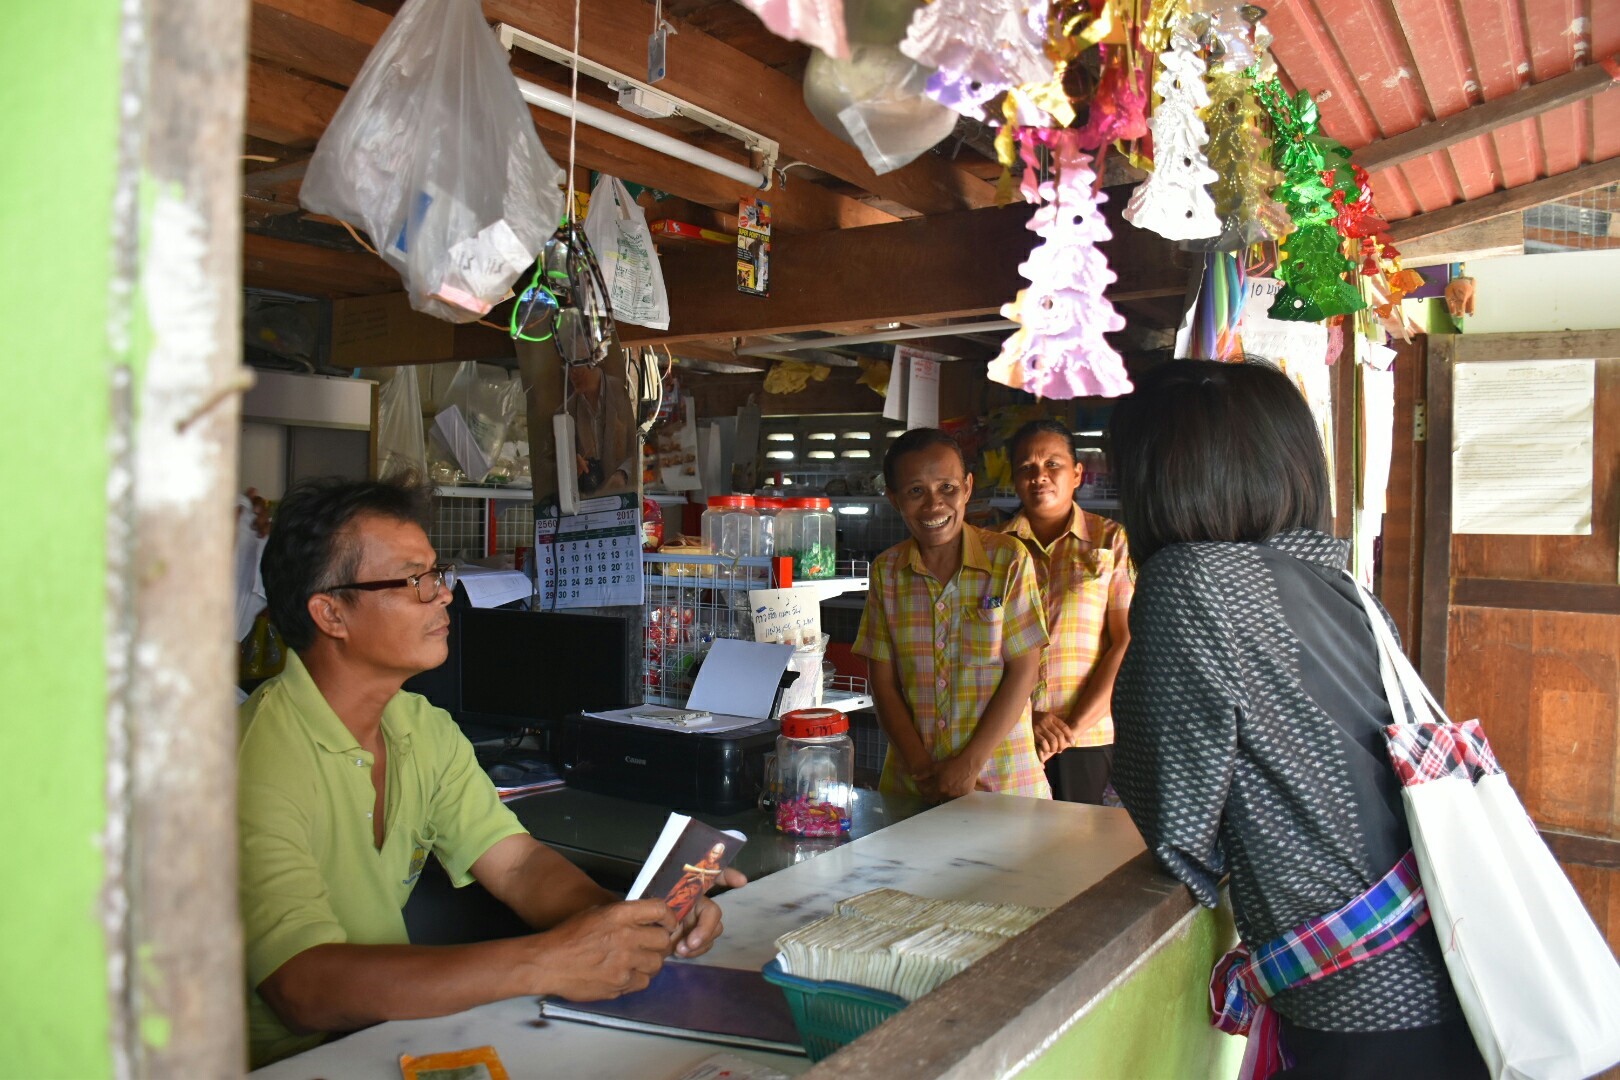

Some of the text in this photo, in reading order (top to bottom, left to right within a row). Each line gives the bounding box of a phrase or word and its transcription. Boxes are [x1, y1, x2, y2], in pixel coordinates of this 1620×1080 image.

[1250, 282, 1263, 298] 10
[616, 510, 634, 520] 2017
[537, 519, 557, 529] 2560
[585, 541, 590, 549] 4
[571, 554, 579, 562] 10
[584, 553, 591, 561] 11
[597, 552, 606, 560] 12
[611, 551, 620, 559] 13
[559, 567, 567, 575] 16
[572, 566, 579, 574] 17
[585, 565, 593, 573] 18
[598, 564, 606, 572] 19
[611, 563, 620, 571] 20
[626, 562, 634, 570] 21
[571, 578, 580, 586] 24
[585, 577, 593, 585] 25
[598, 576, 606, 584] 26
[612, 575, 621, 583] 27
[626, 575, 635, 583] 28
[624, 756, 646, 766] Canon
